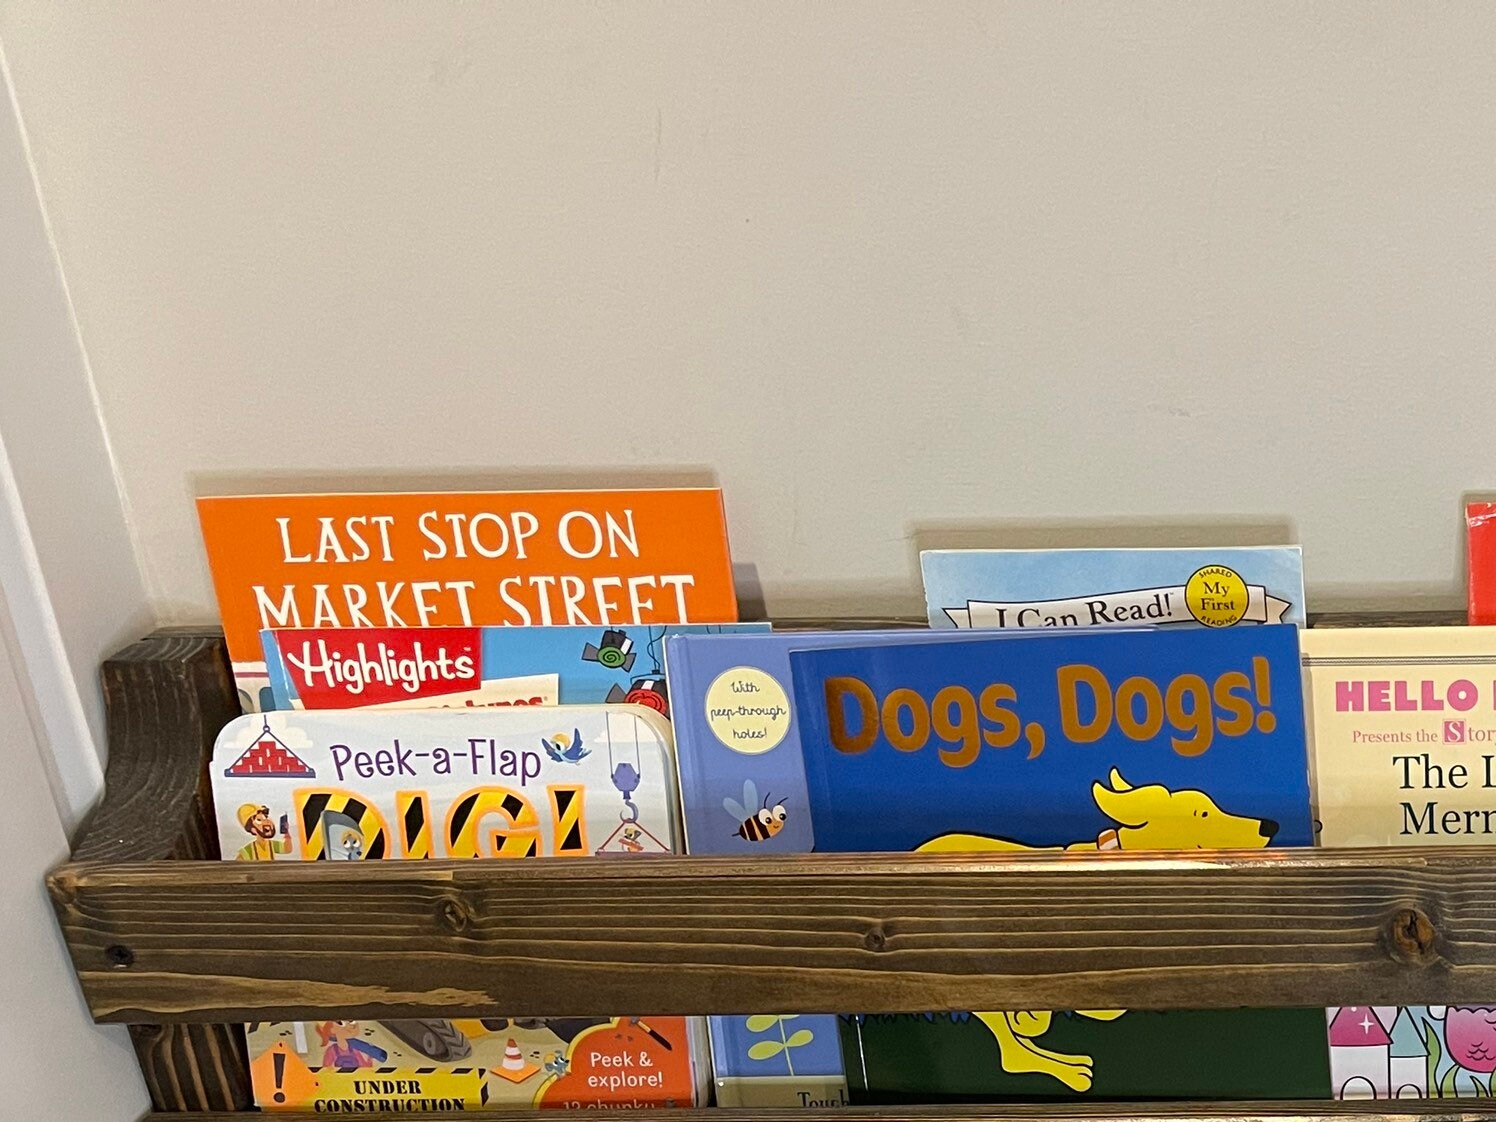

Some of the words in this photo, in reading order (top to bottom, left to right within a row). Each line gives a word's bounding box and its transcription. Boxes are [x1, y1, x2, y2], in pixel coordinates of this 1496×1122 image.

[276, 516, 394, 564] LAST
[418, 510, 539, 561] STOP
[558, 509, 640, 559] ON
[1199, 568, 1232, 578] SHARED
[1203, 581, 1230, 597] My
[252, 580, 476, 628] MARKET
[499, 574, 695, 627] STREET
[1200, 597, 1236, 610] First
[994, 608, 1007, 627] I
[1017, 608, 1078, 627] Can
[1085, 593, 1173, 625] Read!
[1201, 614, 1237, 627] READING
[288, 639, 475, 695] Highlights
[731, 681, 760, 693] With
[1335, 679, 1479, 712] HELLO
[710, 704, 786, 721] peep-through
[825, 674, 1046, 769] Dogs,
[1057, 655, 1277, 758] Dogs!
[733, 726, 767, 739] holes!
[1352, 730, 1412, 744] Presents
[1416, 729, 1438, 743] the
[330, 738, 542, 786] Peek-a-Flap
[1392, 754, 1468, 789] The
[292, 784, 591, 859] DIG!
[590, 1052, 634, 1068] Peek
[639, 1052, 654, 1067] &
[353, 1080, 422, 1095] UNDER
[588, 1071, 663, 1091] explore!
[314, 1098, 465, 1113] CONSTRUCTION
